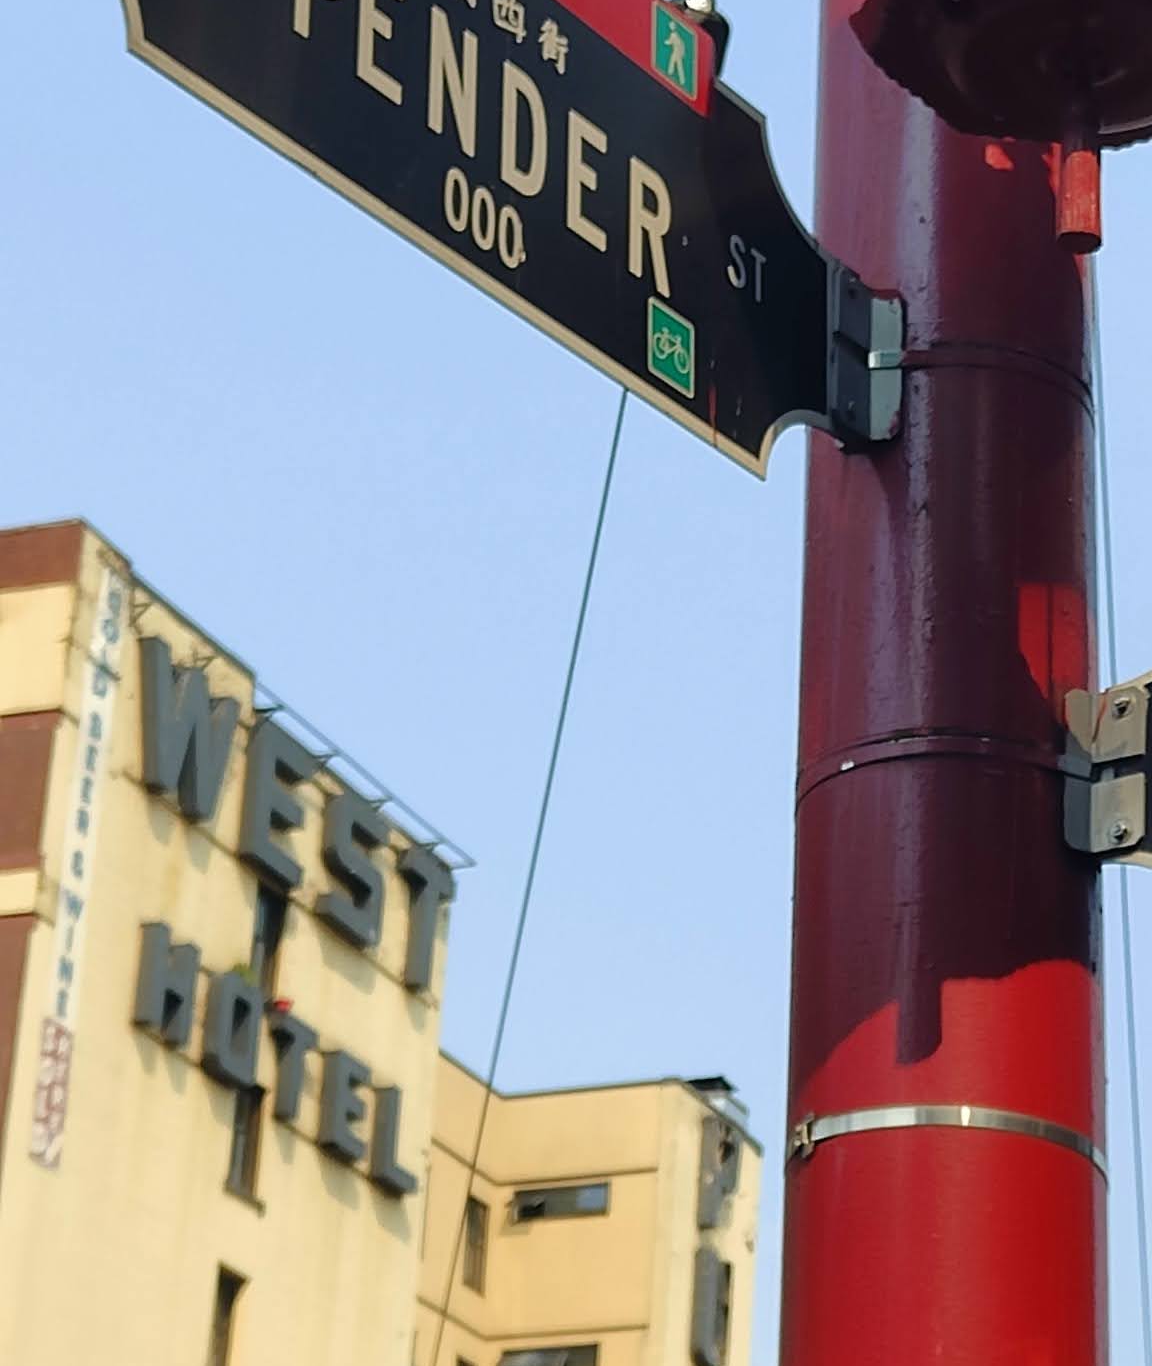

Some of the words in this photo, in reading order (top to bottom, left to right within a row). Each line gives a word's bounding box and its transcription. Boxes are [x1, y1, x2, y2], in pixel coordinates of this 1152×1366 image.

[444, 166, 525, 269] 000
[727, 235, 767, 302] ST
[138, 635, 458, 994] WEST
[133, 922, 417, 1198] HOTEL
